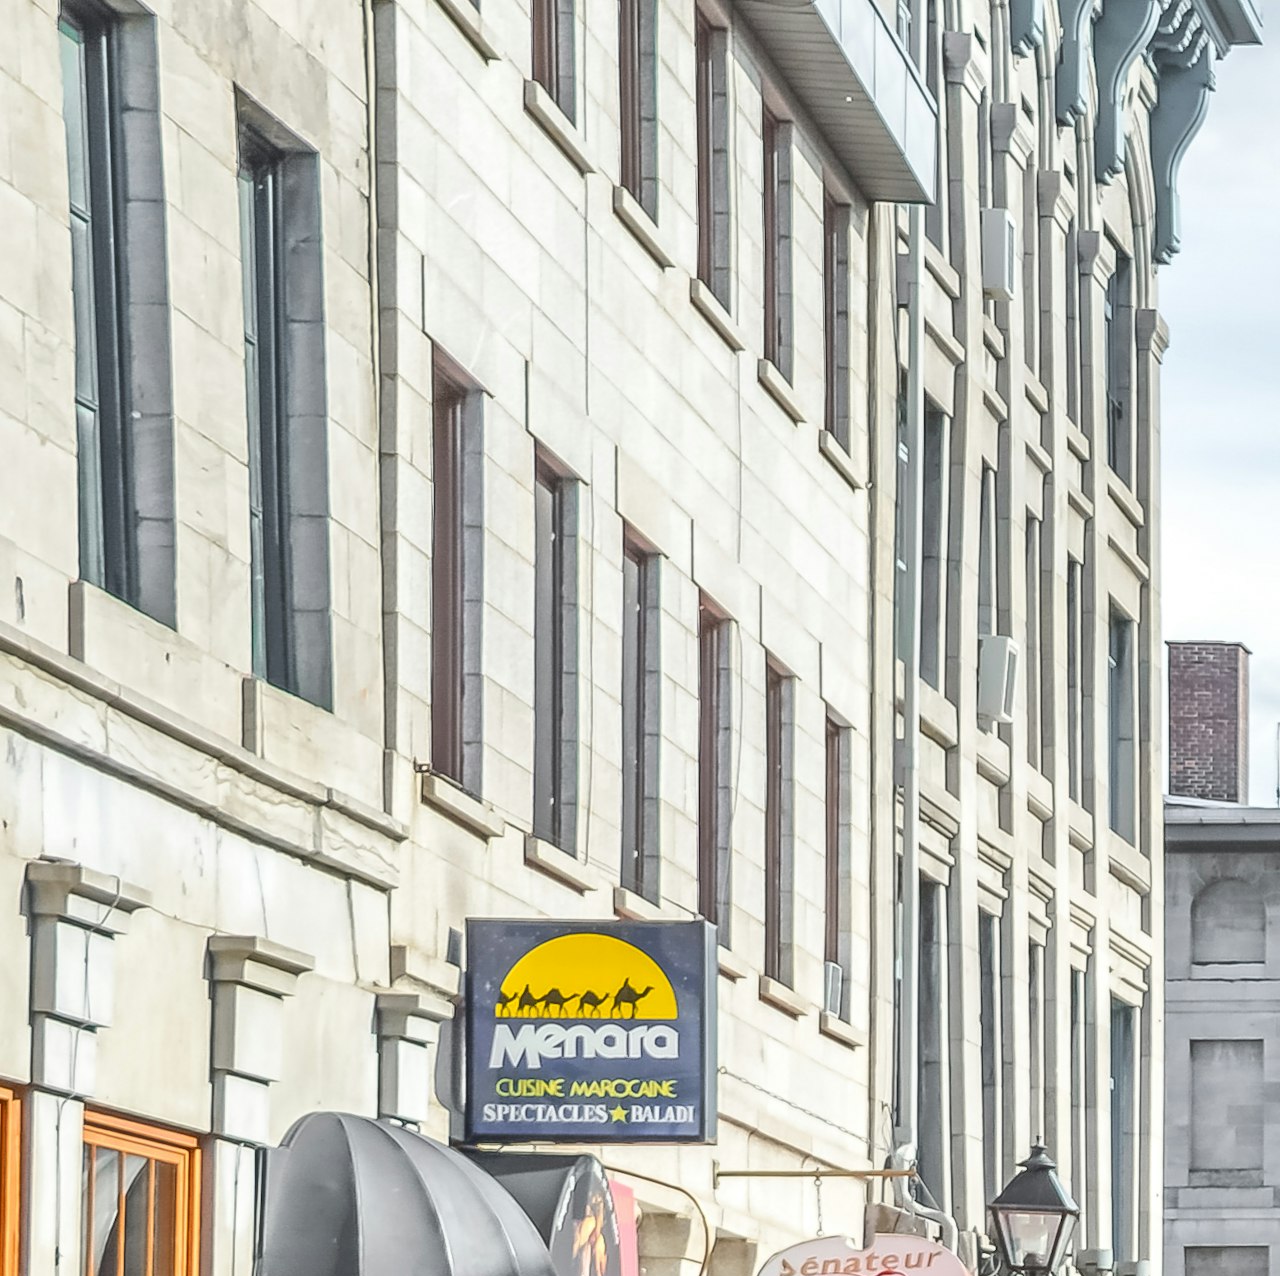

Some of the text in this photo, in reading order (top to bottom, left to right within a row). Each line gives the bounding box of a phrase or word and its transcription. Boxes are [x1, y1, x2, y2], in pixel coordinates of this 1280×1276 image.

[488, 1023, 680, 1070] Menara
[495, 1077, 679, 1099] CUISINE MAROCAINE
[482, 1103, 696, 1124] SPECTACLES BALADI
